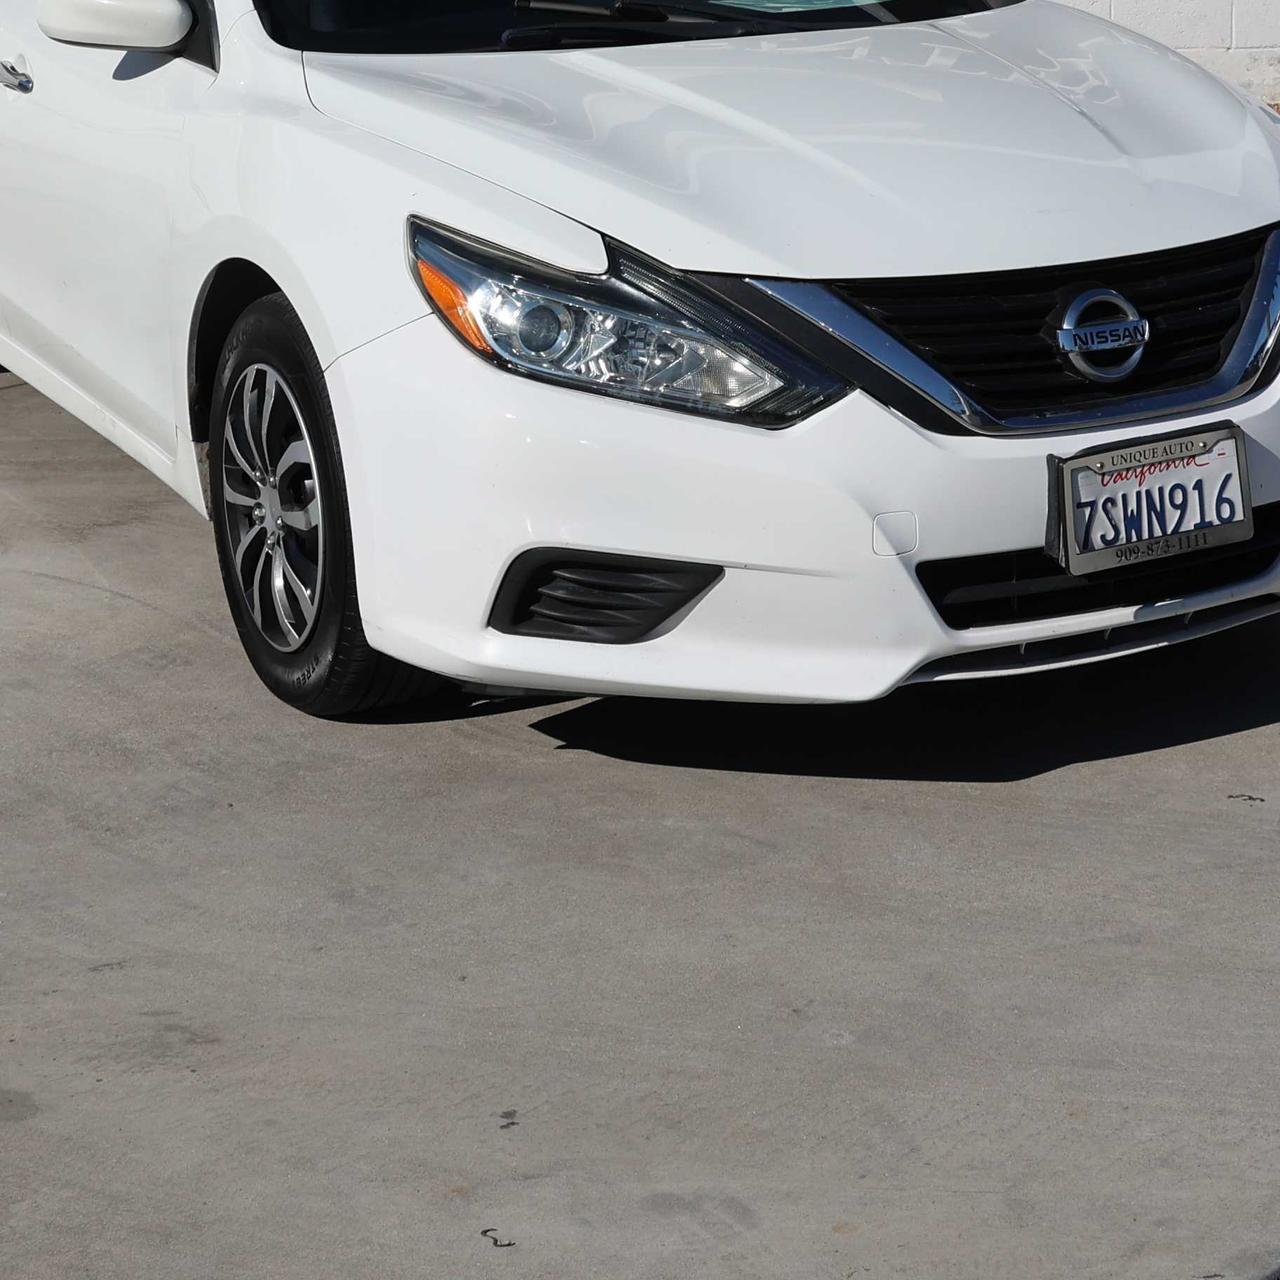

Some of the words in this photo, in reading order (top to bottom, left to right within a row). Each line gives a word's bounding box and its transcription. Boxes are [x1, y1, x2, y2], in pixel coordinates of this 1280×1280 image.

[1072, 324, 1146, 347] NISSAN
[1111, 447, 1160, 467] UNIQUE
[1160, 440, 1194, 457] AUTO
[1076, 473, 1236, 550] 7SWN916
[1115, 532, 1208, 563] 909-873-1111
